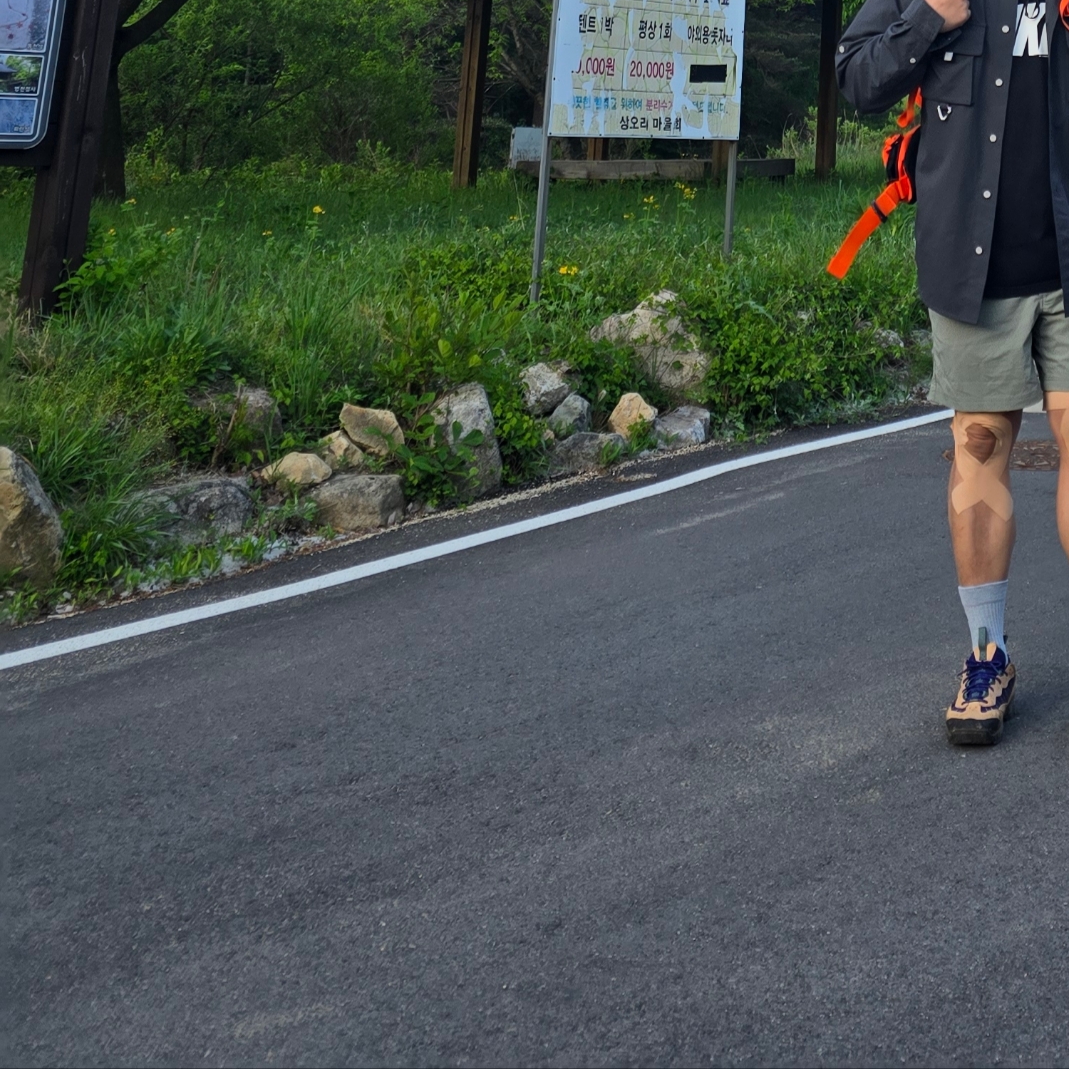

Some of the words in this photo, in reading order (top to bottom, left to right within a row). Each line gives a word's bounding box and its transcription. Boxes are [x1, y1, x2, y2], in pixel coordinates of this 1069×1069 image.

[578, 14, 596, 34] 텐트
[638, 20, 657, 40] 평상
[659, 22, 673, 41] 1회
[630, 60, 675, 80] 20,000원
[620, 116, 648, 132] 상오리
